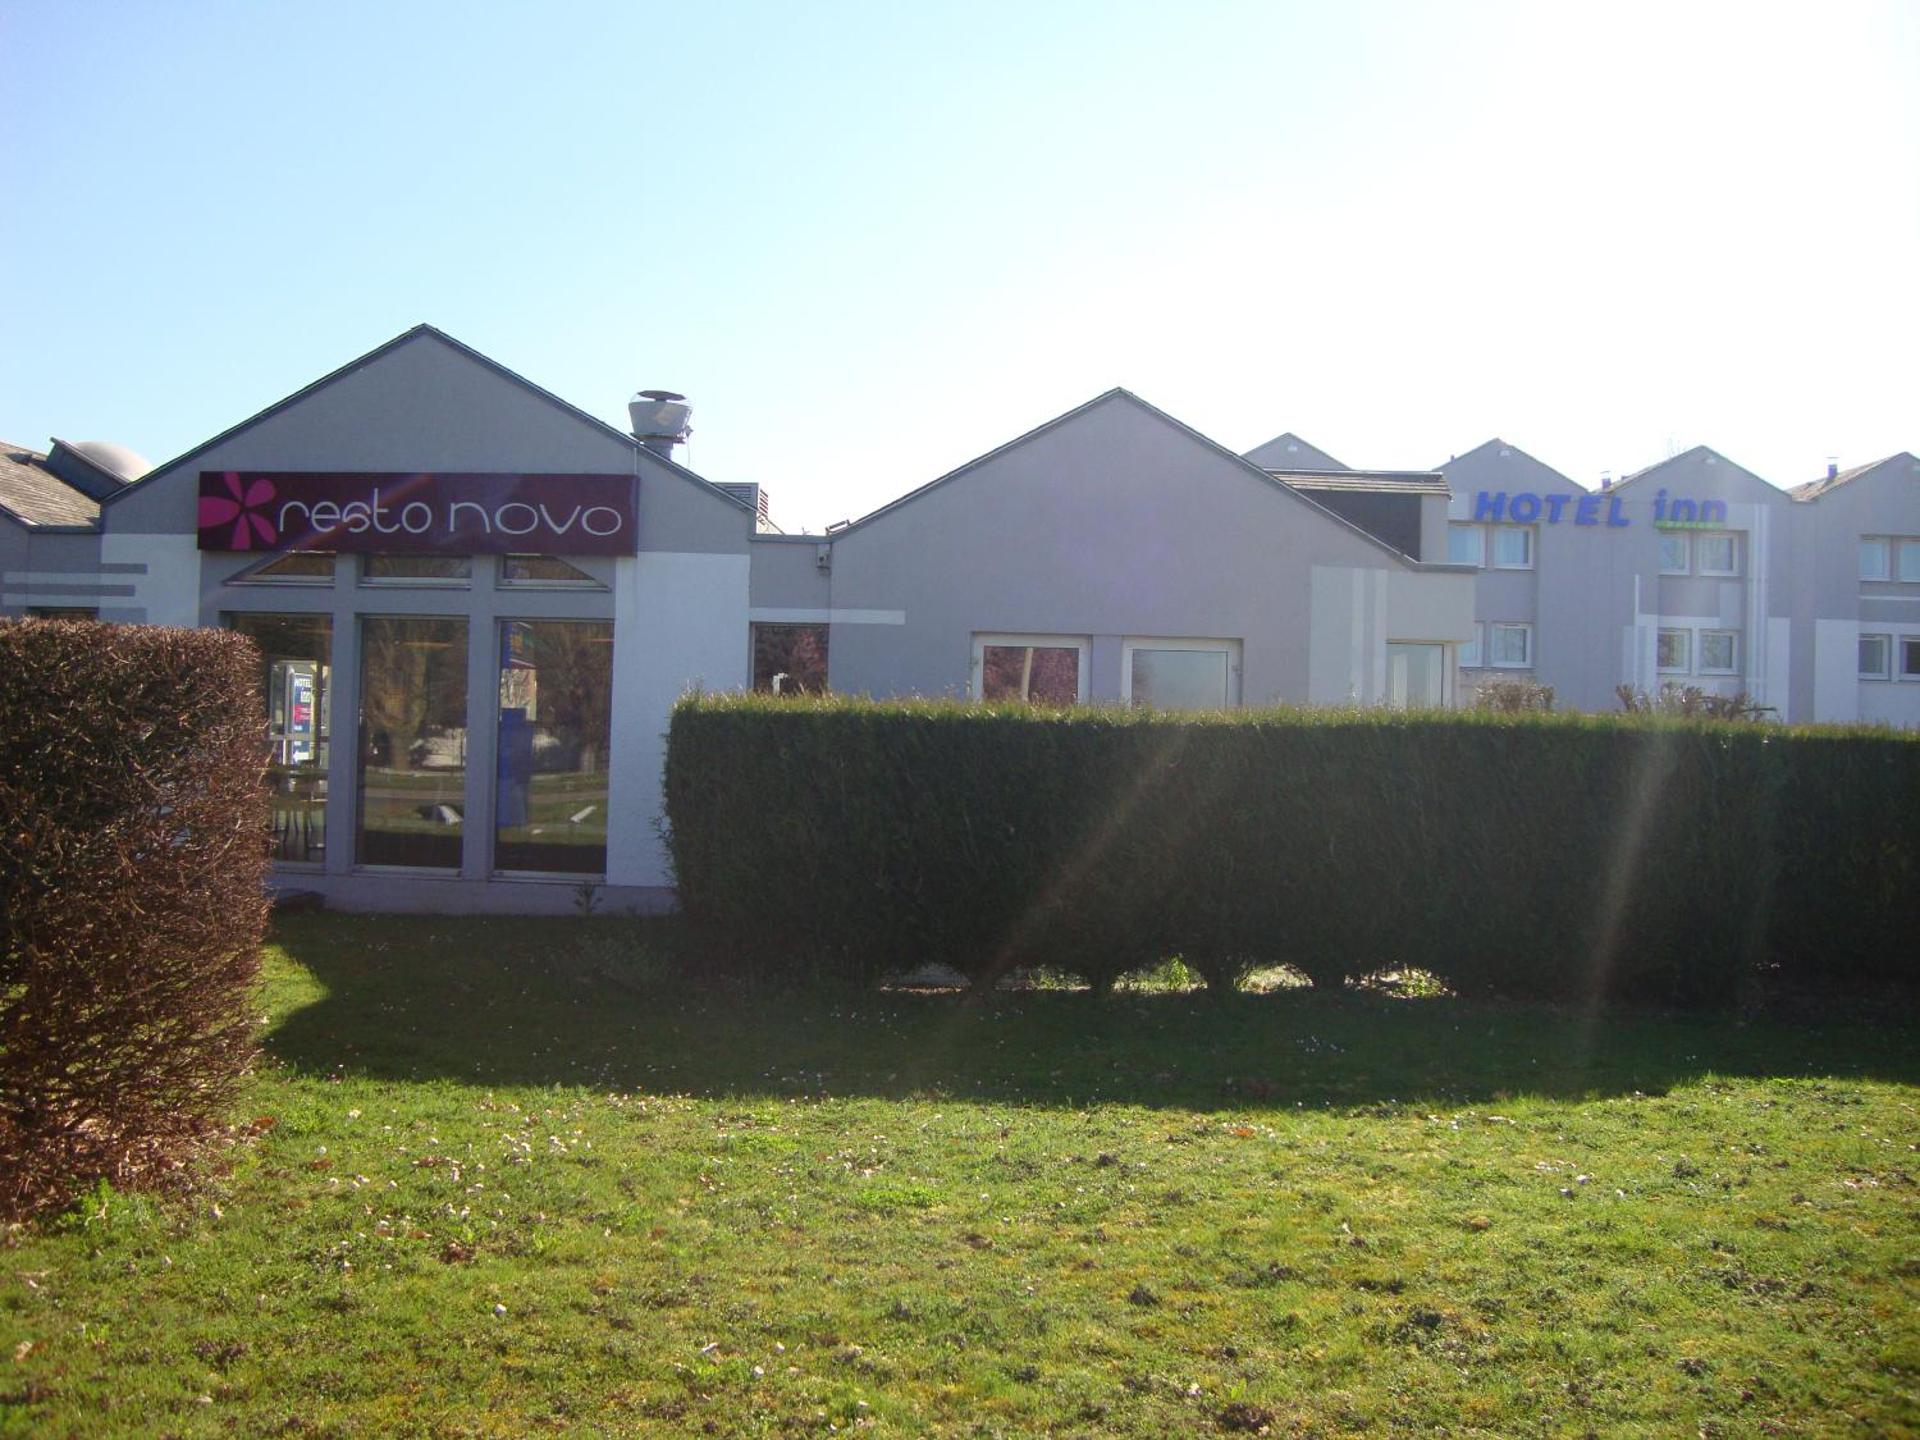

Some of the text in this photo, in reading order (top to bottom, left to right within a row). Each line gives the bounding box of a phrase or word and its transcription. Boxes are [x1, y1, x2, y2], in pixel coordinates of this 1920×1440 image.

[278, 487, 622, 536] resto novo
[1474, 488, 1728, 527] HOTEL inn
